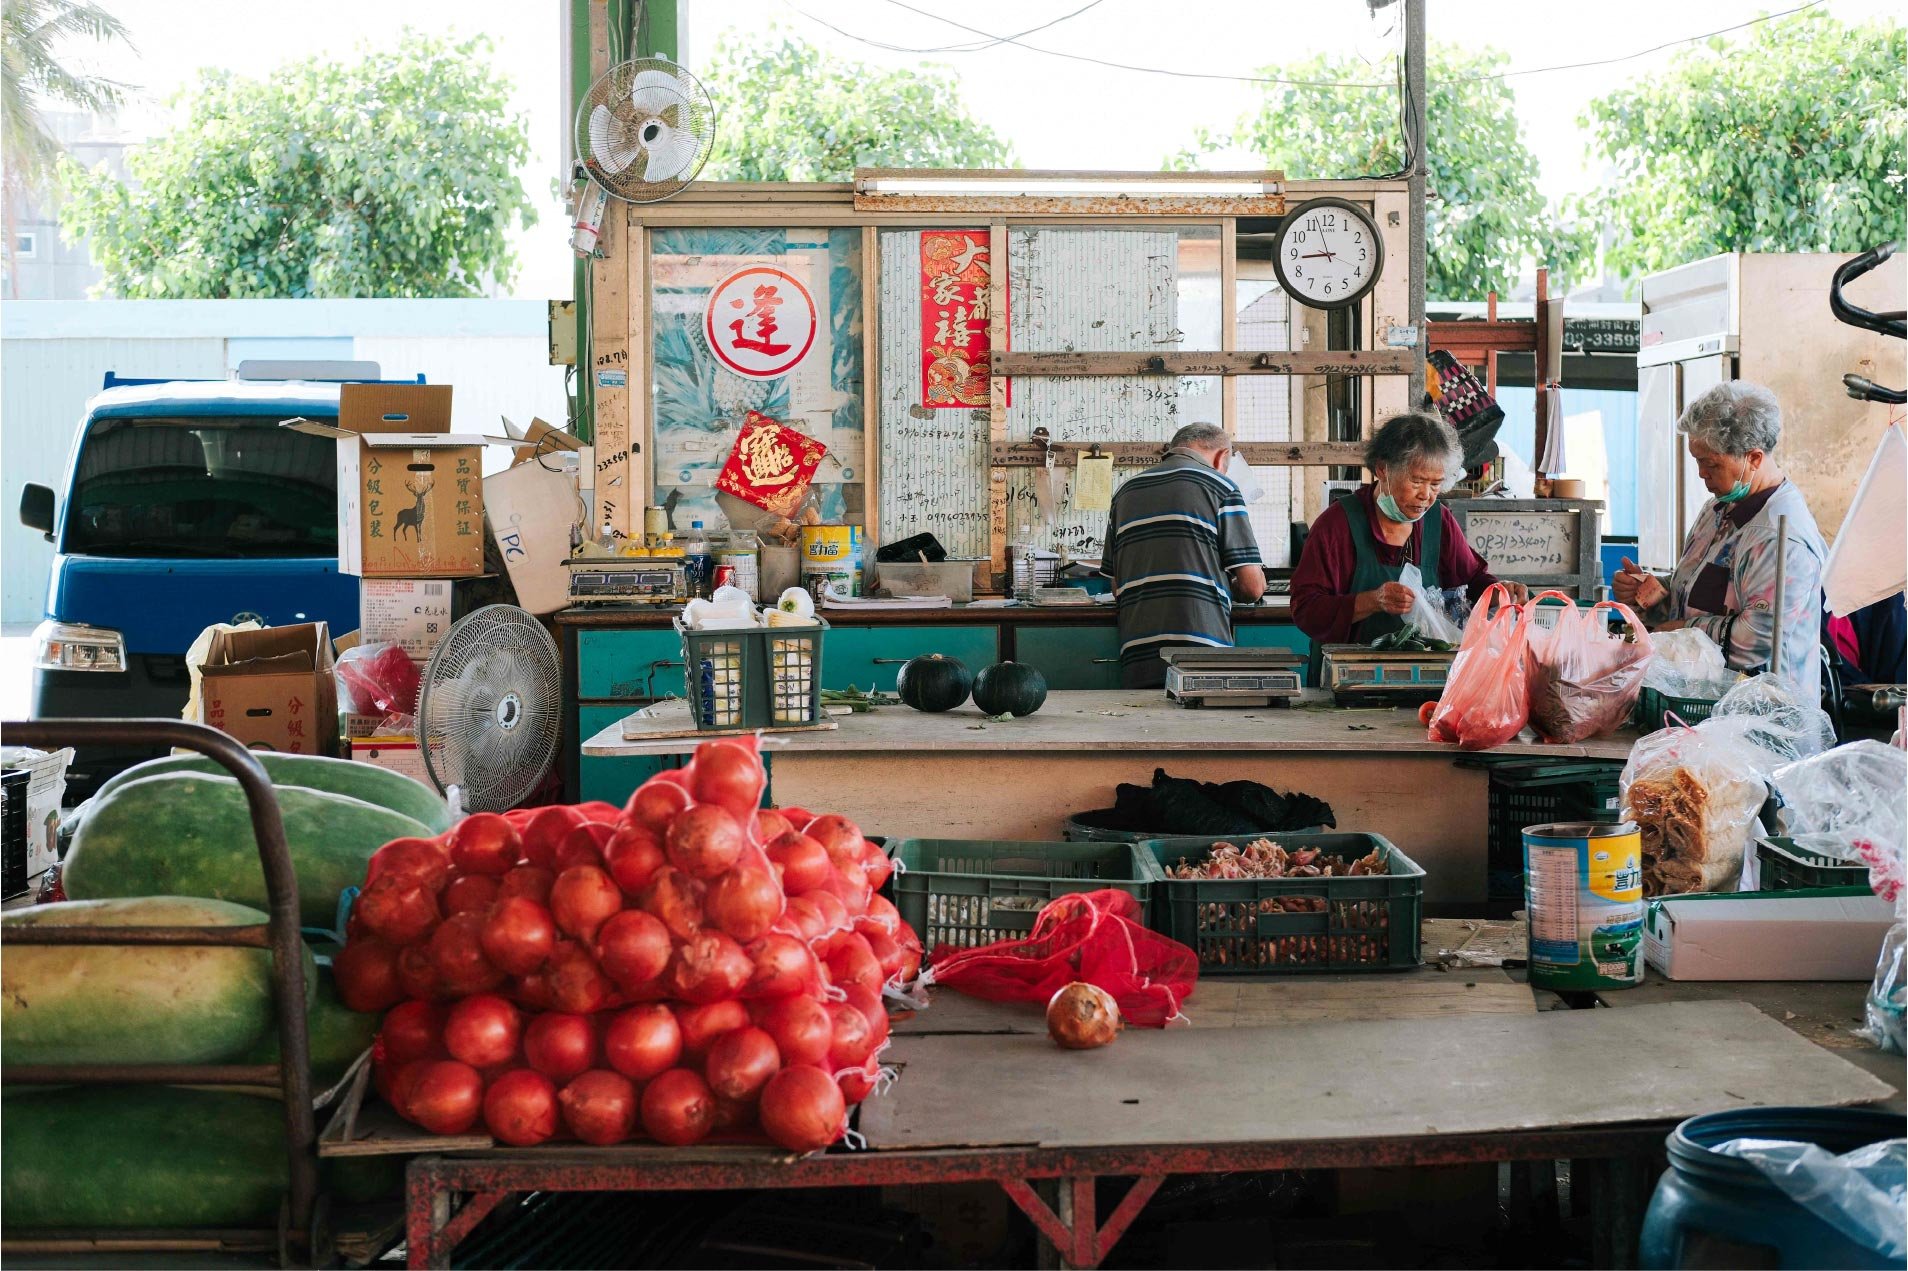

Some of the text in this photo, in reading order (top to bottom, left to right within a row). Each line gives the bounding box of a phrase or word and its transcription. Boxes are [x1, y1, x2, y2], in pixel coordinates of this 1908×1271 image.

[1306, 219, 1316, 232] 11
[1322, 214, 1335, 227] 12
[1343, 220, 1348, 231] 1
[1293, 231, 1305, 243] 10
[1354, 231, 1361, 244] 2
[1290, 248, 1298, 260] 9
[1358, 248, 1366, 261] 3
[1295, 265, 1302, 278] 8
[1354, 266, 1361, 278] 4
[1307, 278, 1314, 290] 7
[1324, 282, 1332, 294] 6
[1342, 278, 1349, 290] 5
[728, 284, 792, 357] 逢
[366, 457, 384, 539] 分級包裝
[455, 458, 473, 536] 品質保証
[1614, 867, 1642, 891] 豐力
